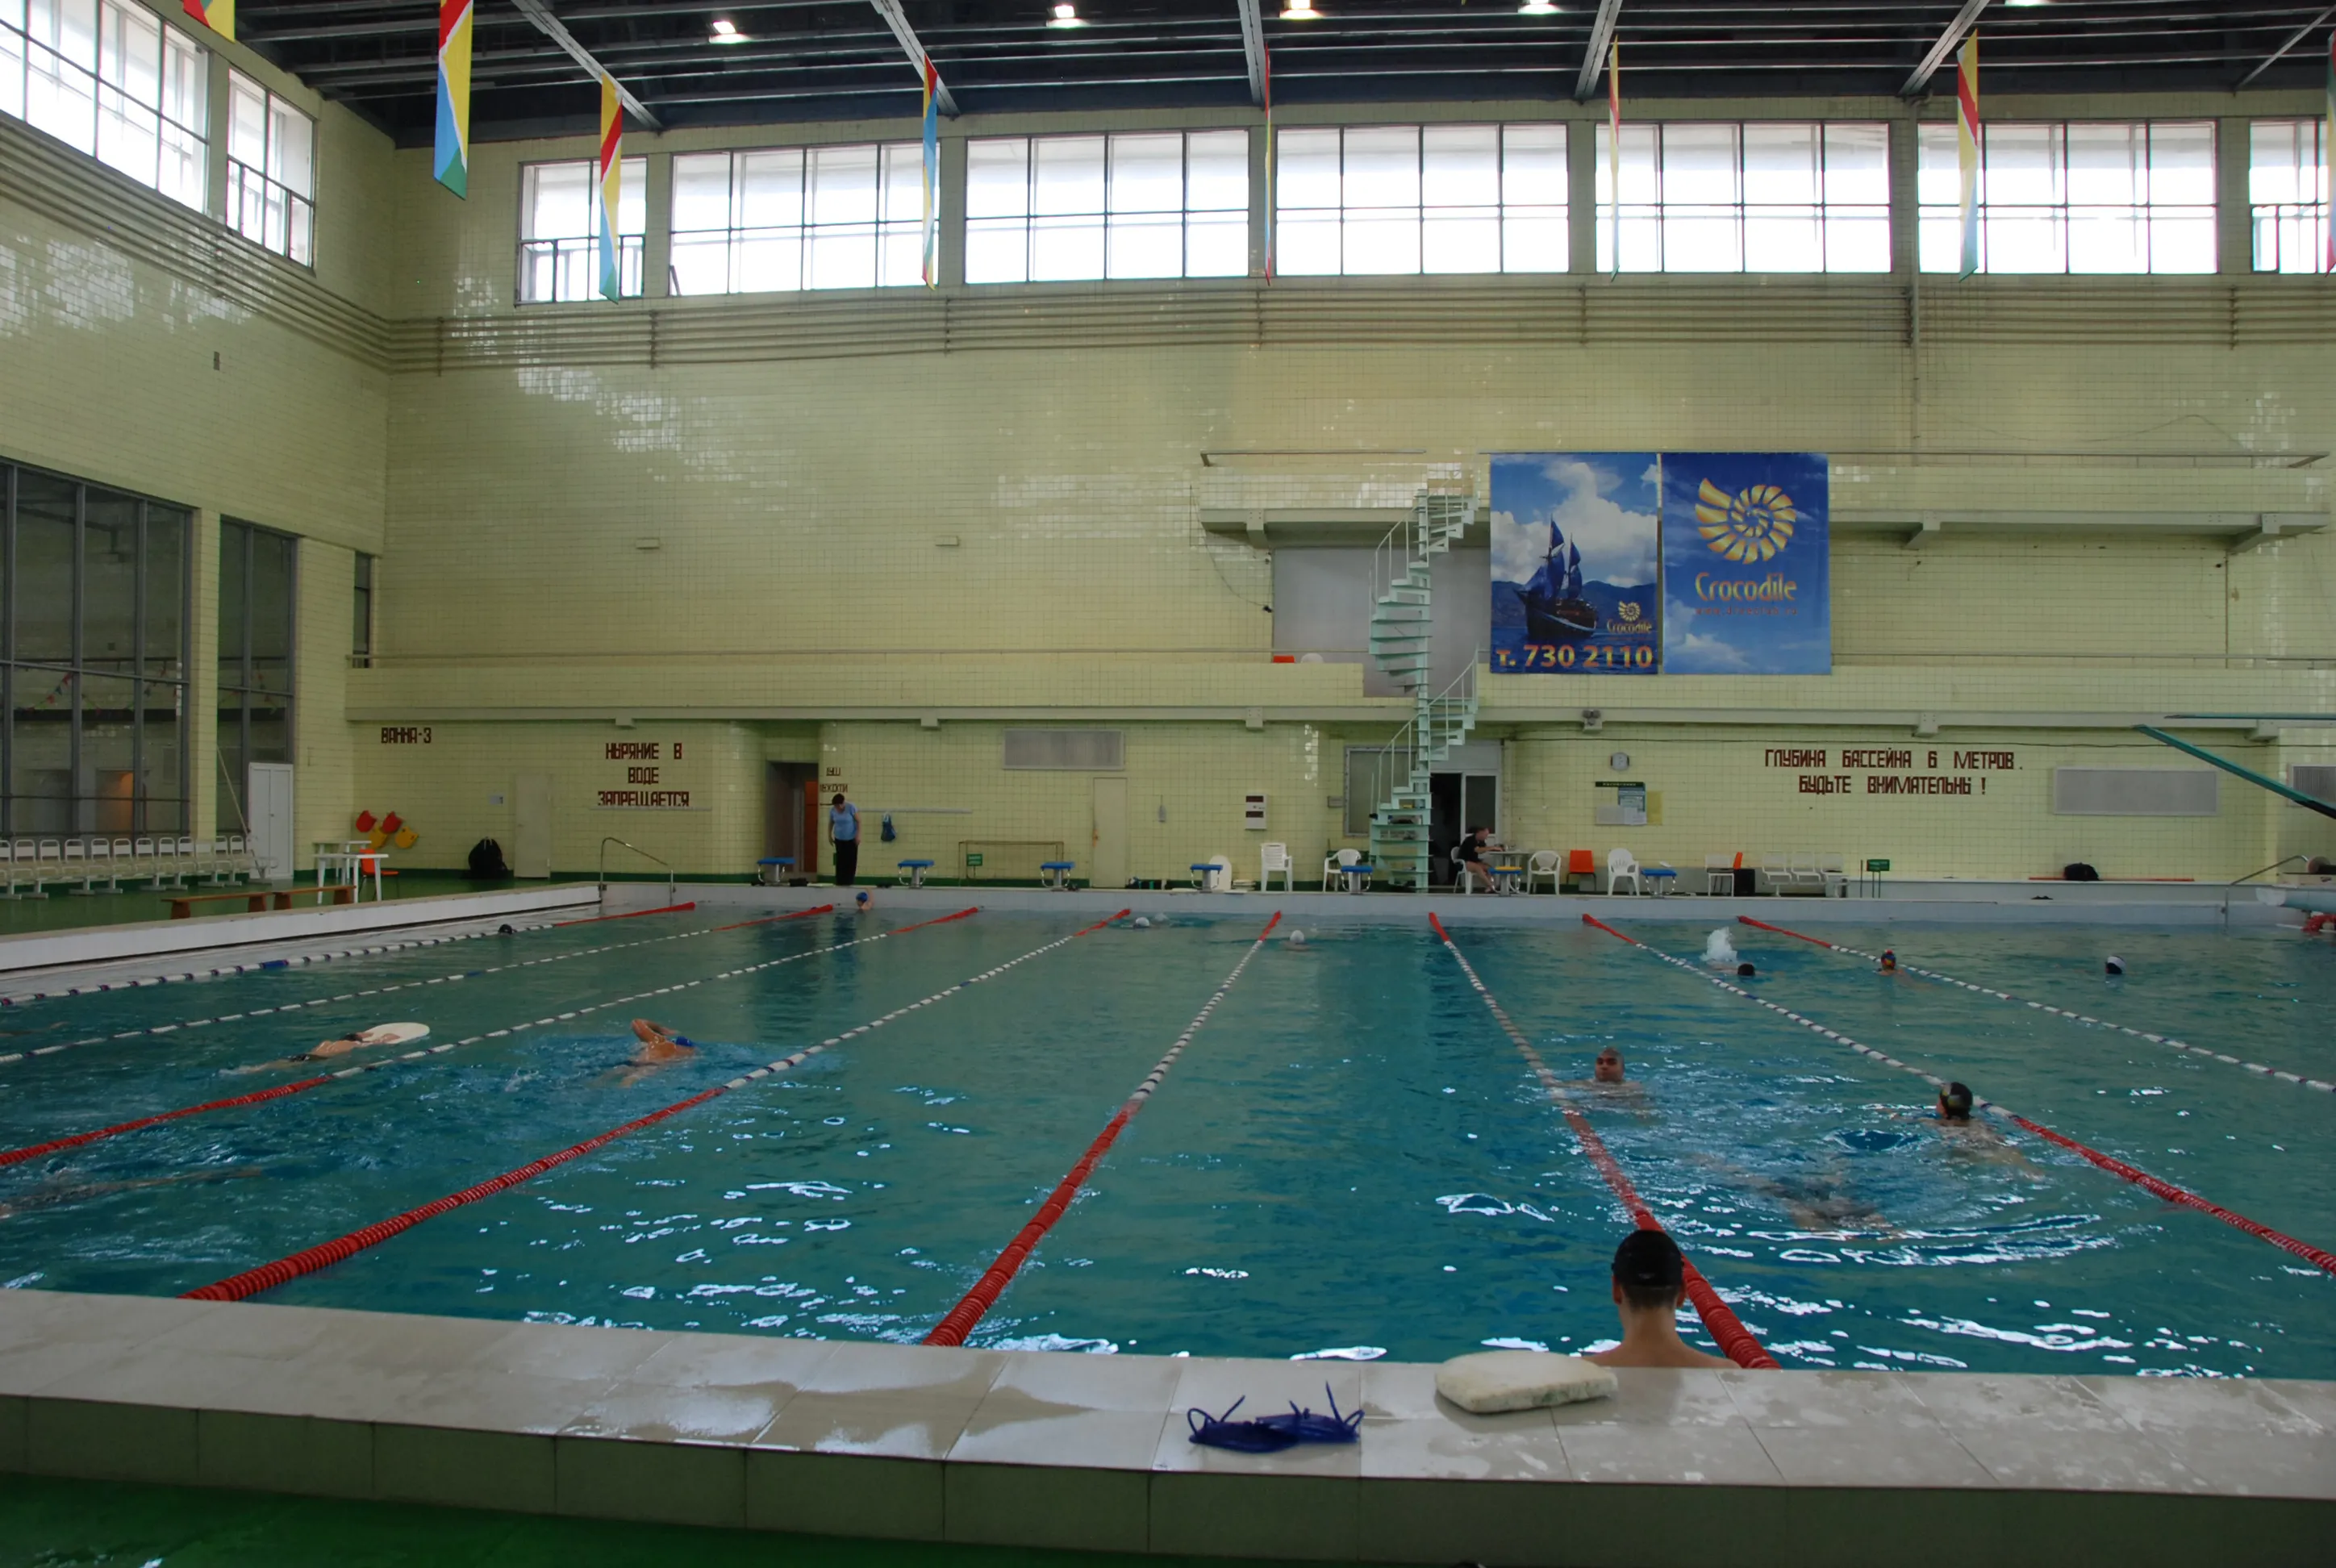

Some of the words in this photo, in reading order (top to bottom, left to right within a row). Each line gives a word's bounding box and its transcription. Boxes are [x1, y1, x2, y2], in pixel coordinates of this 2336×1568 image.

[1695, 572, 1797, 601] Crocodile
[1607, 619, 1652, 634] Crocodile
[1524, 644, 1575, 667] 730
[1583, 644, 1654, 668] 2110
[381, 727, 432, 744] ВАННА-3
[606, 743, 659, 759] НЫРЯНИЕ
[674, 743, 682, 759] В
[1765, 749, 1826, 767] ГЛУБИНА
[1842, 748, 1912, 769] БАССЕЙНА
[1928, 750, 1938, 769] 6
[628, 767, 659, 785] ВОДЕ
[1799, 775, 1851, 794] БУДЬТЕ
[598, 791, 690, 807] ЗАПРЕЩАЕТСЯ
